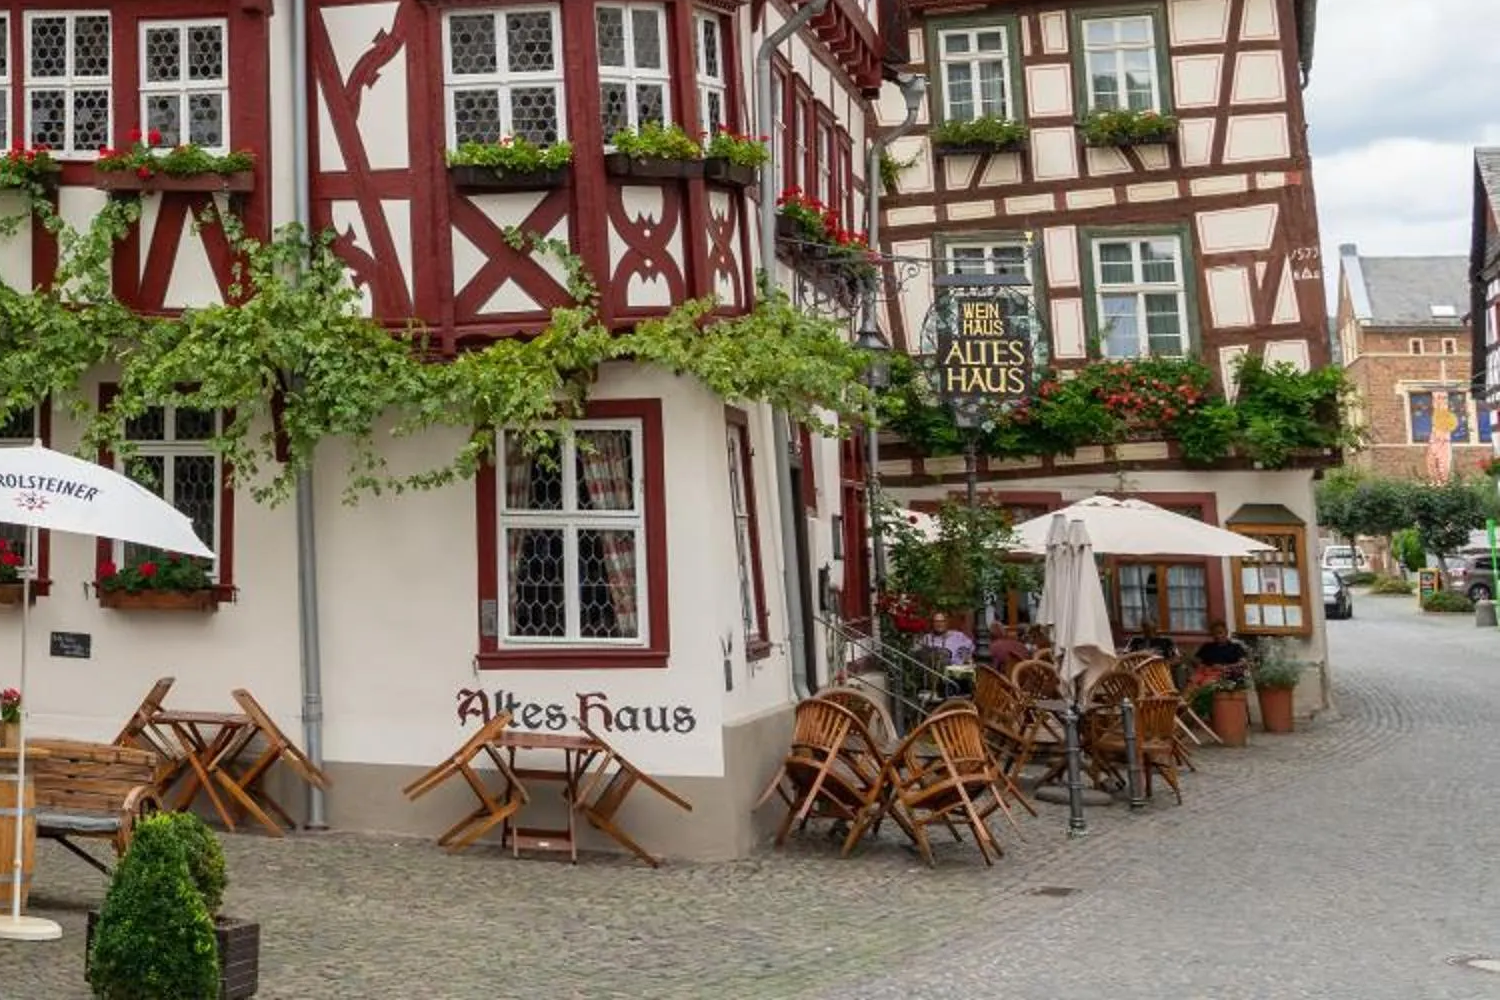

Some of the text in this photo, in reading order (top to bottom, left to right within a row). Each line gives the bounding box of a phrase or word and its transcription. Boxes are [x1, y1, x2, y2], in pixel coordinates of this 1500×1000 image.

[962, 302, 999, 319] WEIN
[962, 319, 1005, 336] HAUS
[943, 340, 1025, 366] ALTES
[946, 366, 1025, 394] HAUS
[575, 692, 697, 734] Haus
